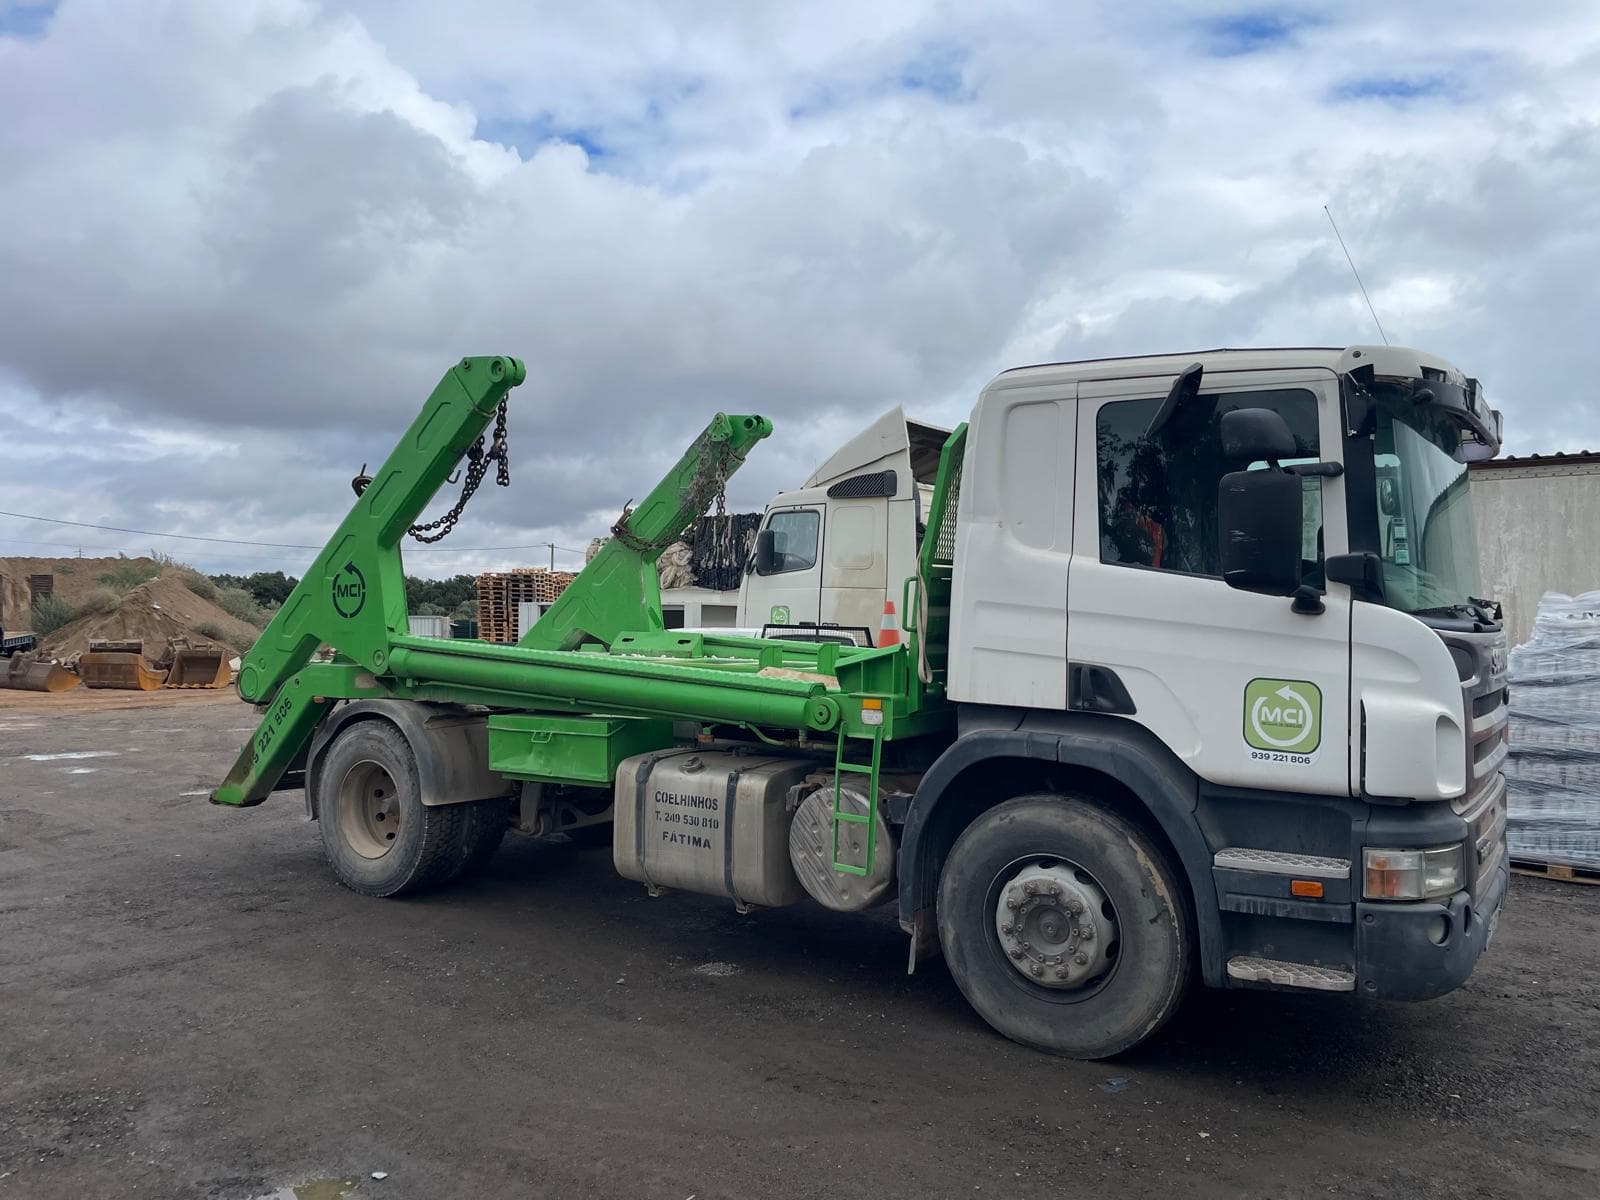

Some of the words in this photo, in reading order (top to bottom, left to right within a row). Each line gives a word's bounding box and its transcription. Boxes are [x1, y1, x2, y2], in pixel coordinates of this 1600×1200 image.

[337, 583, 361, 598] MCI
[1261, 706, 1303, 725] MCI
[1251, 752, 1270, 760] 939
[1273, 754, 1288, 762] 221
[1290, 756, 1311, 764] 806
[655, 790, 719, 811] COELHINHOS
[665, 812, 680, 823] 249
[683, 814, 699, 827] 530
[702, 817, 719, 829] 810
